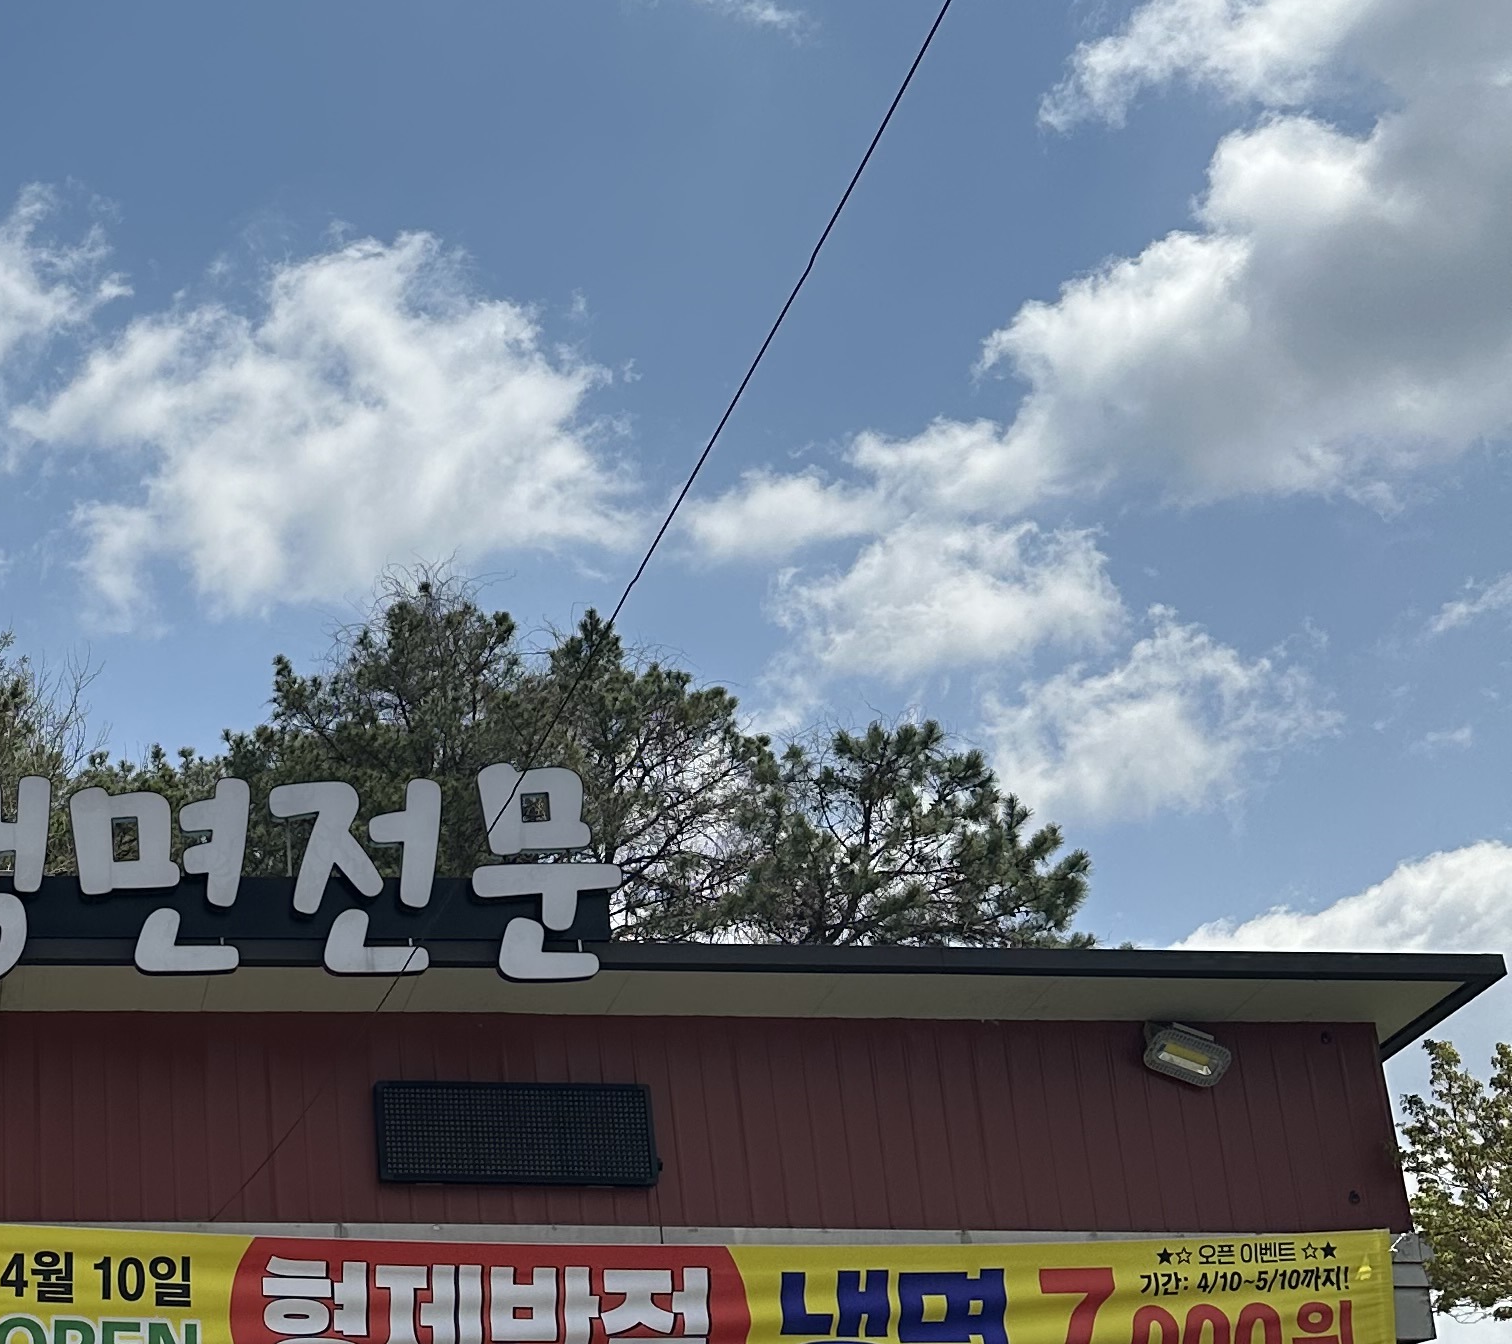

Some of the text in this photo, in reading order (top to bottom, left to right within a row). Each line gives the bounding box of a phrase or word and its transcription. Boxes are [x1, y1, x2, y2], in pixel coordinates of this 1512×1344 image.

[1198, 1241, 1296, 1265] 오픈 이벤트
[0, 1252, 192, 1308] 4월 10일
[1140, 1265, 1350, 1296] 기간: 4/10~5/10까지!
